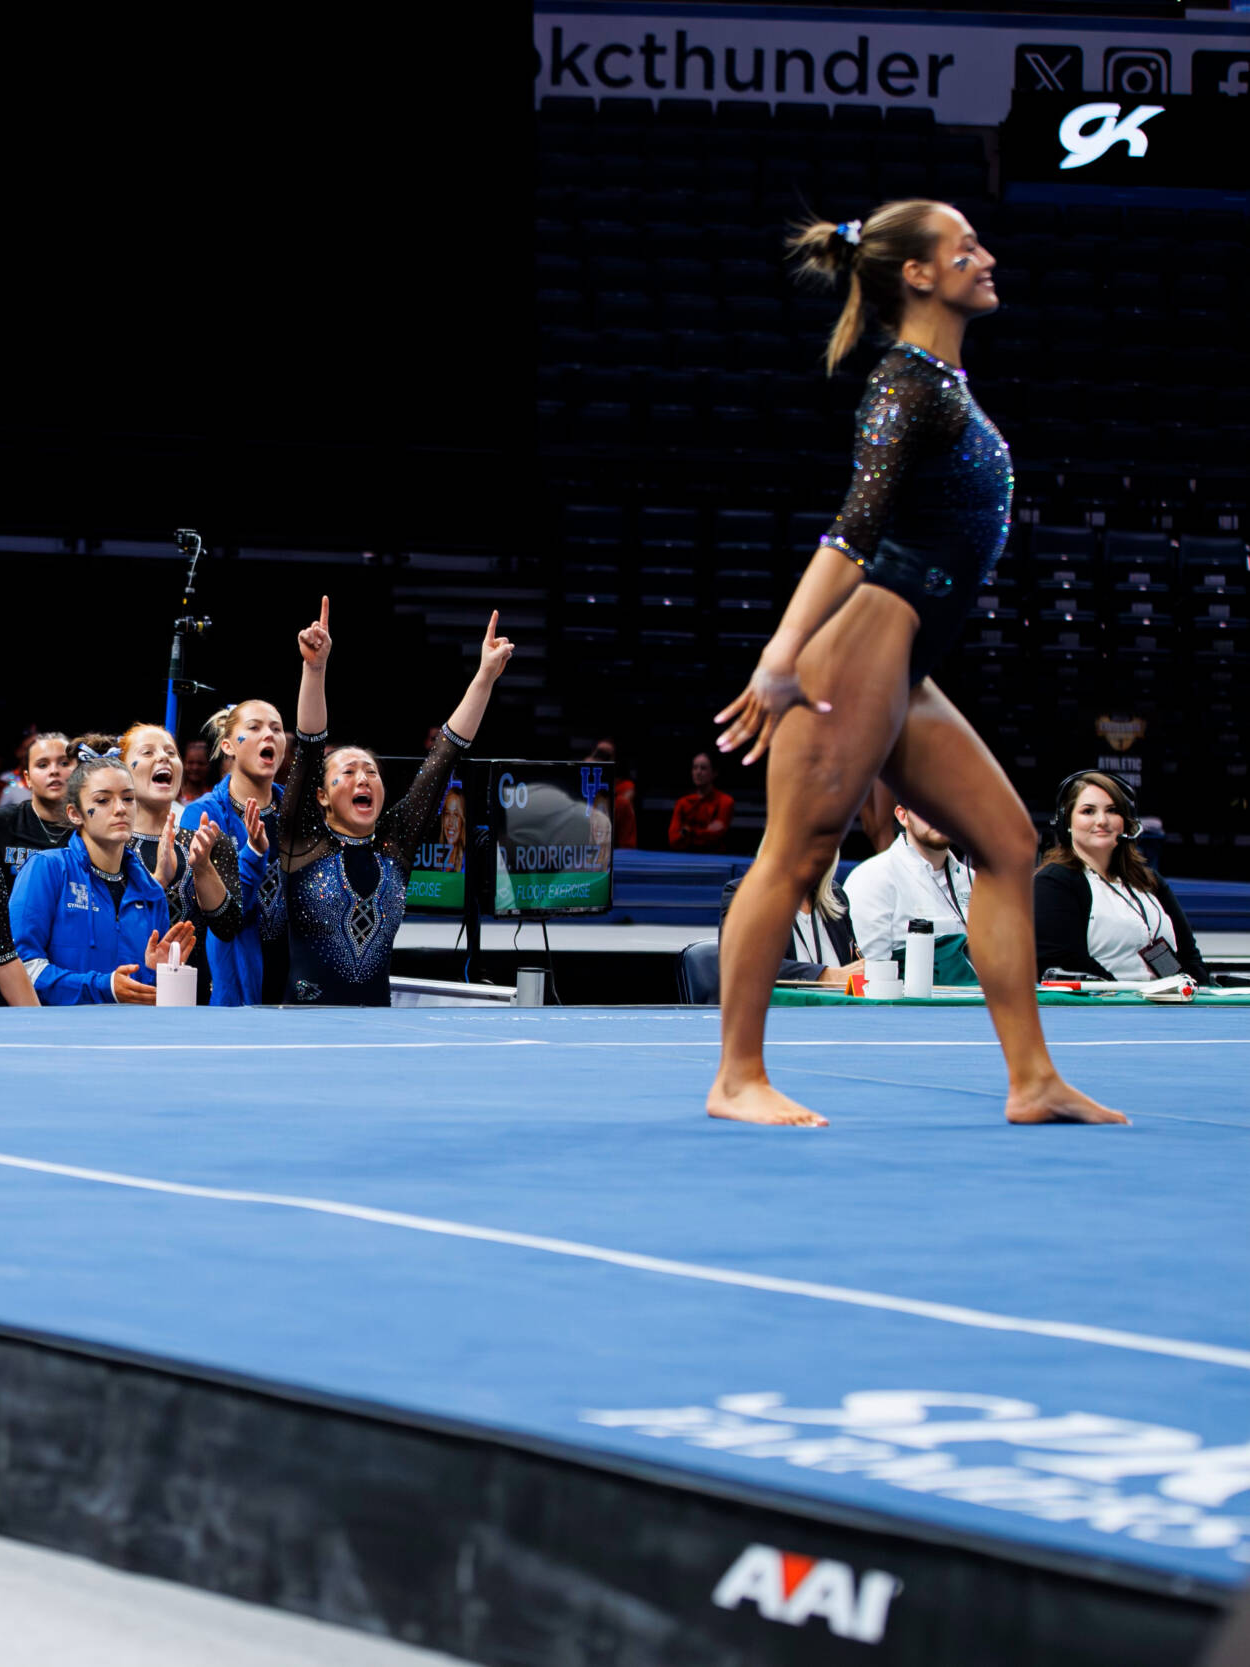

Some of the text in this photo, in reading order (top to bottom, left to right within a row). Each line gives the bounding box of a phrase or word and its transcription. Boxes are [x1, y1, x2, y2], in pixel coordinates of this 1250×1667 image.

[498, 772, 528, 809] Go
[515, 844, 602, 871] RODRIGUEZ
[517, 882, 591, 900] FLOOR EXERCISE
[711, 1543, 897, 1645] AAI
